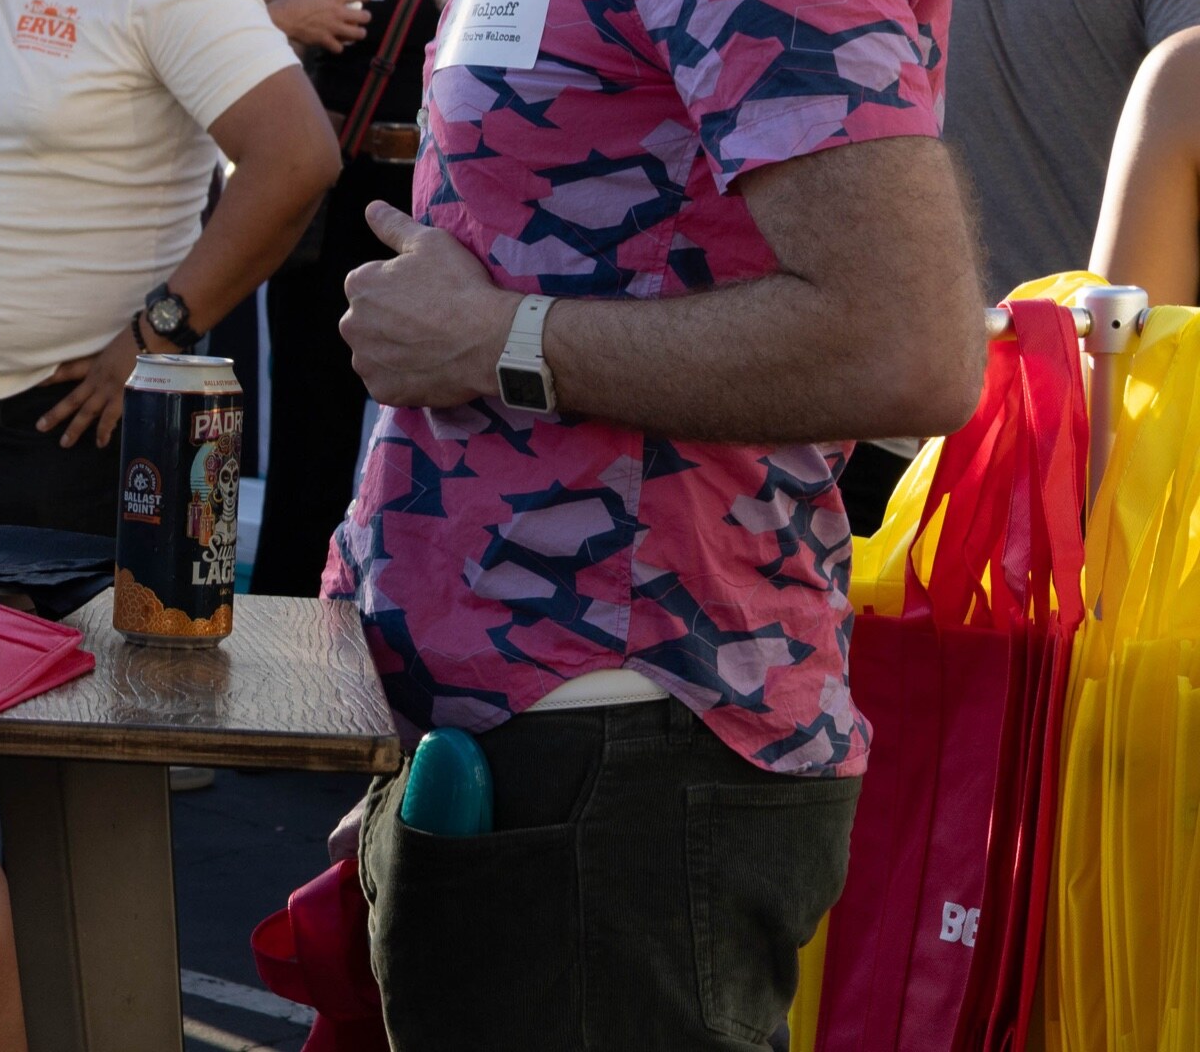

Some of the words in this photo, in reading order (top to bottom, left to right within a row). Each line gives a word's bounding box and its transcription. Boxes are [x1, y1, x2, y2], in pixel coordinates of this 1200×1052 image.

[17, 15, 77, 43] ERVA
[485, 31, 521, 43] Welcome
[195, 411, 244, 440] PADR
[124, 490, 162, 505] BALLAST
[127, 502, 155, 515] POINT
